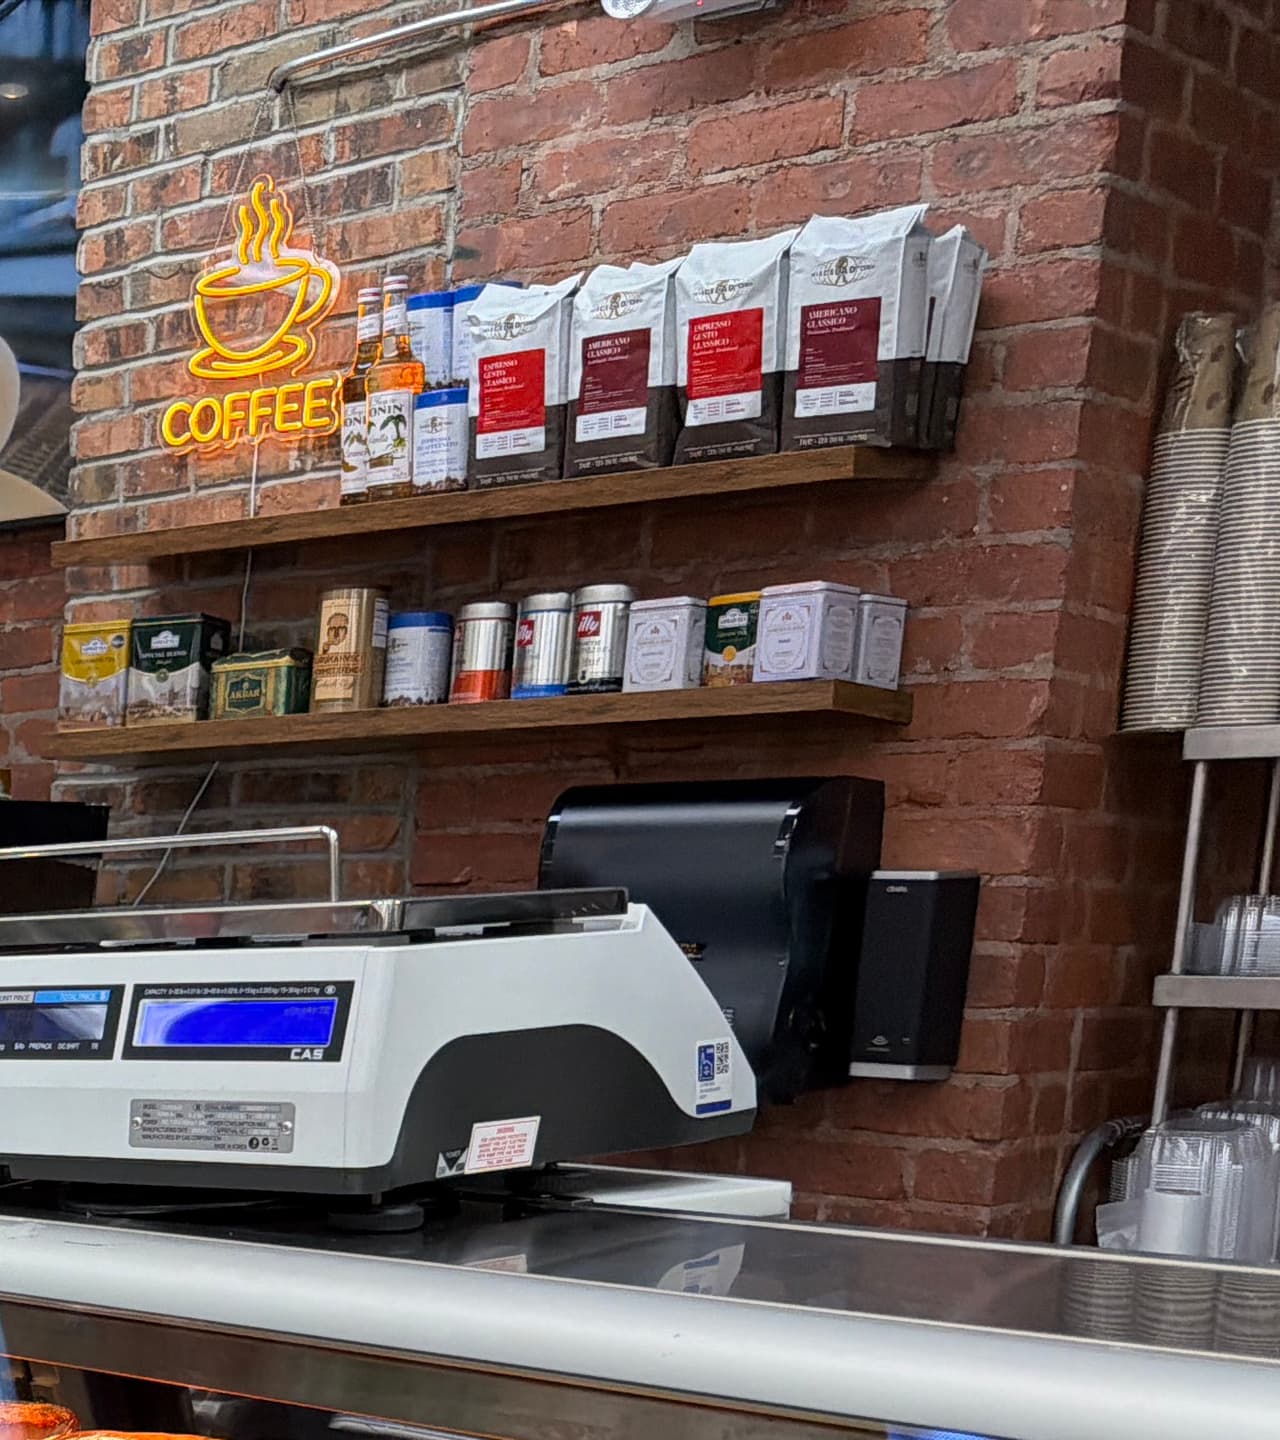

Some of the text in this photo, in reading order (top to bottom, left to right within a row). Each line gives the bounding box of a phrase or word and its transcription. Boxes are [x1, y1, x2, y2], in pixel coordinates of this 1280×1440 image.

[807, 306, 858, 320] AMERICANO
[694, 320, 732, 332] ESPRESSO
[806, 317, 846, 329] CLASSICO
[693, 331, 718, 341] GUSTO
[588, 337, 630, 350] AMERICANO
[693, 338, 730, 350] CLASSICO
[587, 347, 621, 359] CLASSICO
[483, 359, 518, 371] ESPRESSO
[161, 379, 334, 446] COFFEE
[578, 615, 599, 634] illy
[229, 688, 261, 701] AKBAR
[290, 1048, 324, 1060] CAS
